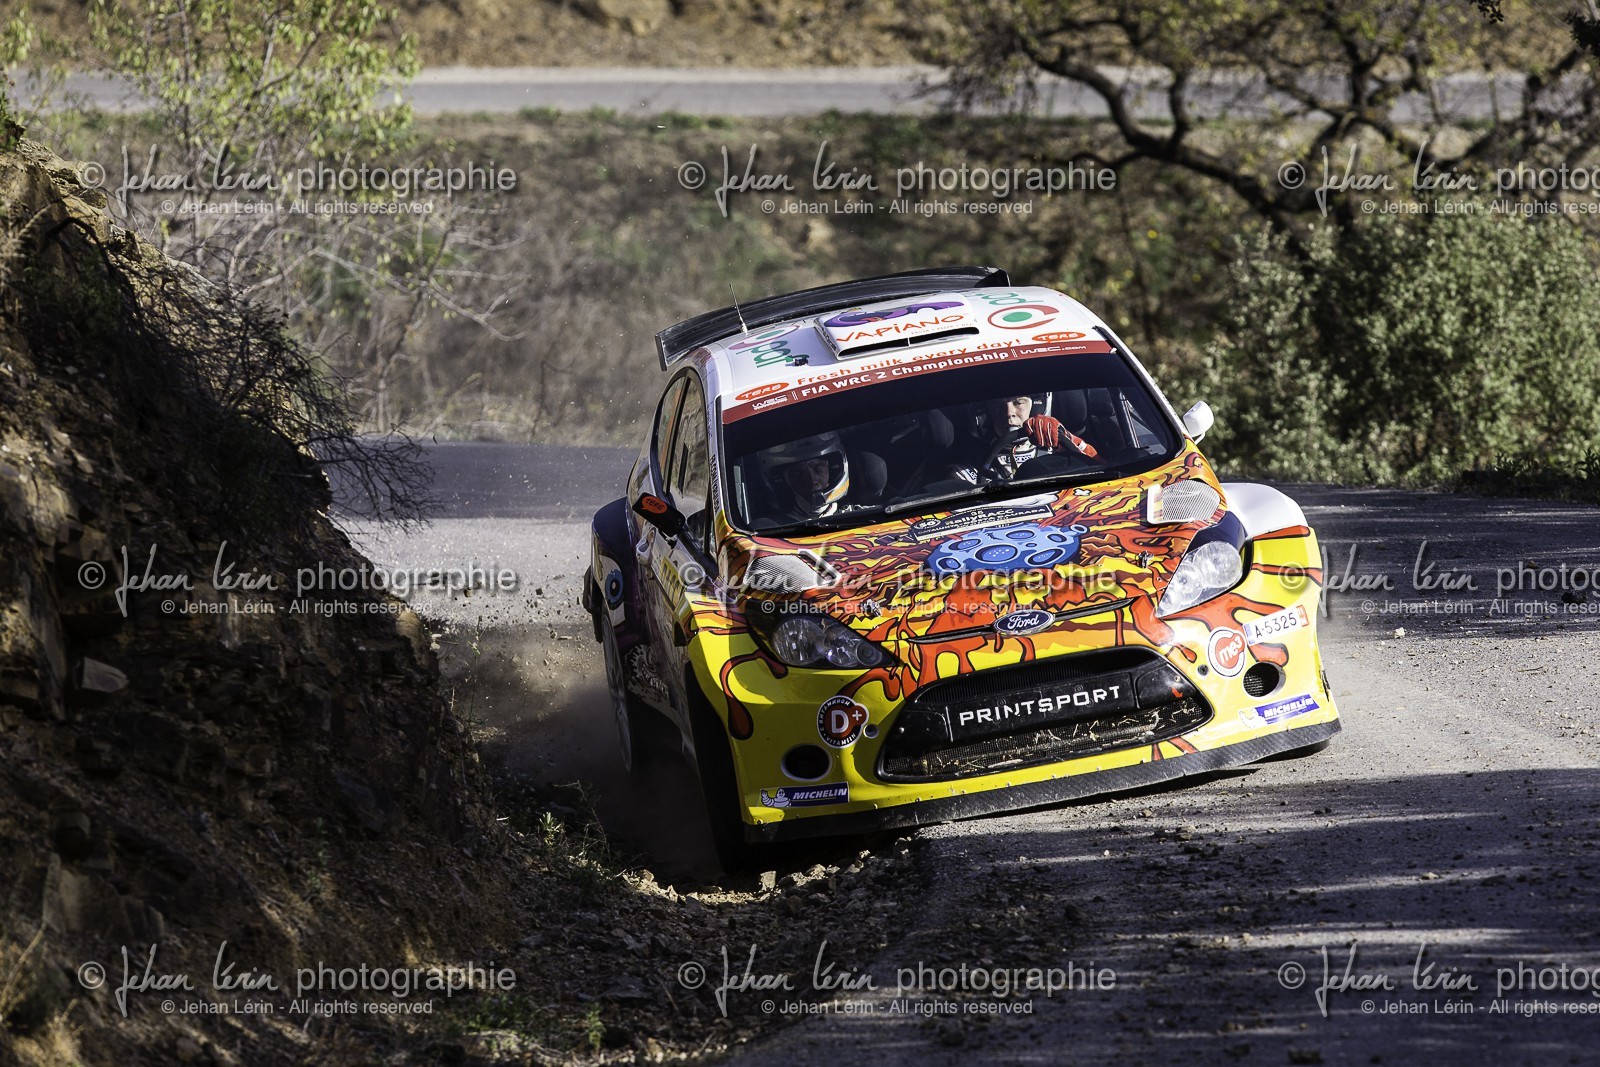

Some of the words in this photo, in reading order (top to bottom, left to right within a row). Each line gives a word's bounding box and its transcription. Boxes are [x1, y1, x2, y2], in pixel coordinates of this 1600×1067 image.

[798, 369, 851, 385] Fresh
[861, 358, 902, 371] milk
[912, 347, 967, 361] every
[977, 339, 1021, 350] day!
[801, 384, 830, 397] FIA
[832, 374, 872, 389] WRC
[876, 371, 888, 380] 2
[891, 351, 1010, 376] Championship
[1007, 613, 1040, 630] Ford
[959, 685, 1120, 726] PRINTSPORT
[1264, 697, 1315, 718] MICHELIN
[793, 788, 847, 800] MICHELIN
